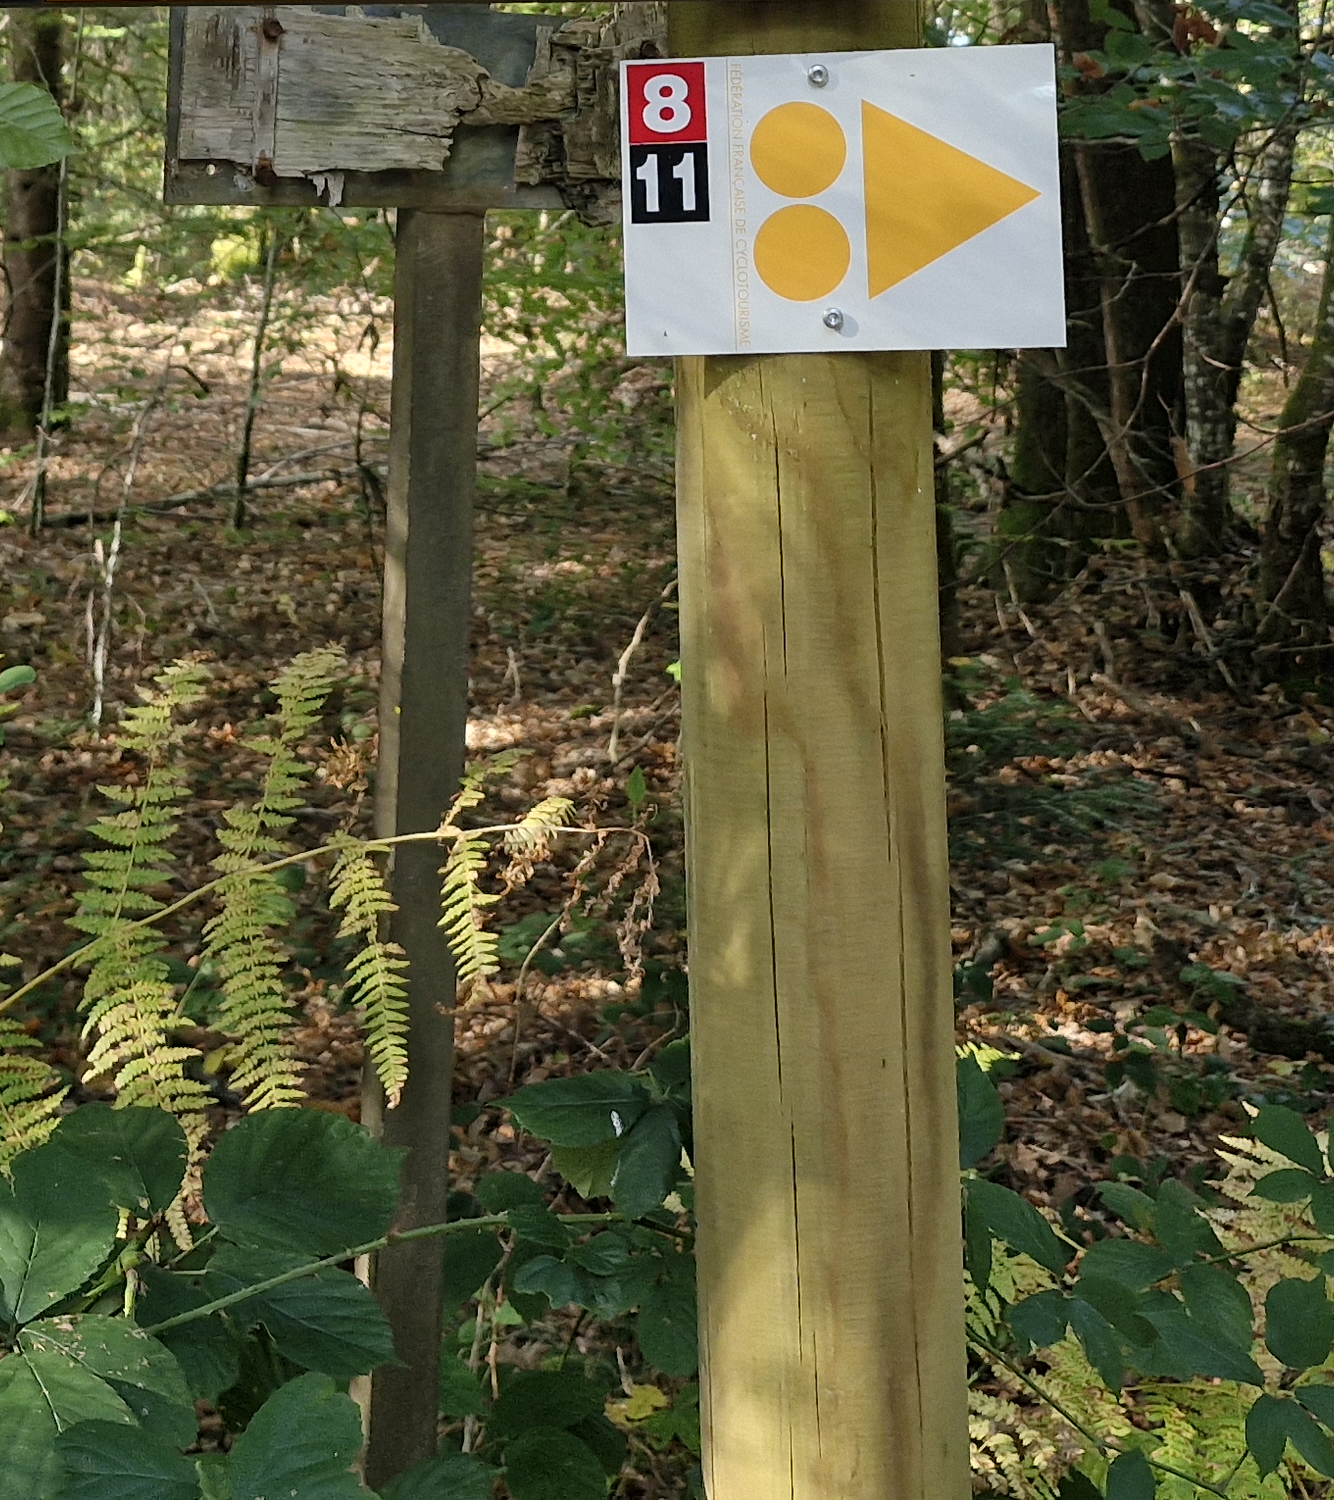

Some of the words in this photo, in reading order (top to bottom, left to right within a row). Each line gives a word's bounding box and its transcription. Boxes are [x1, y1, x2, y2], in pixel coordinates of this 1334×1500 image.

[642, 74, 692, 133] 8
[730, 63, 744, 140] FÉDÉRATION
[636, 152, 696, 213] 11
[732, 144, 747, 214] FRANÇAISE
[735, 218, 747, 235] DE
[736, 238, 751, 347] CYCLOTOURISME
